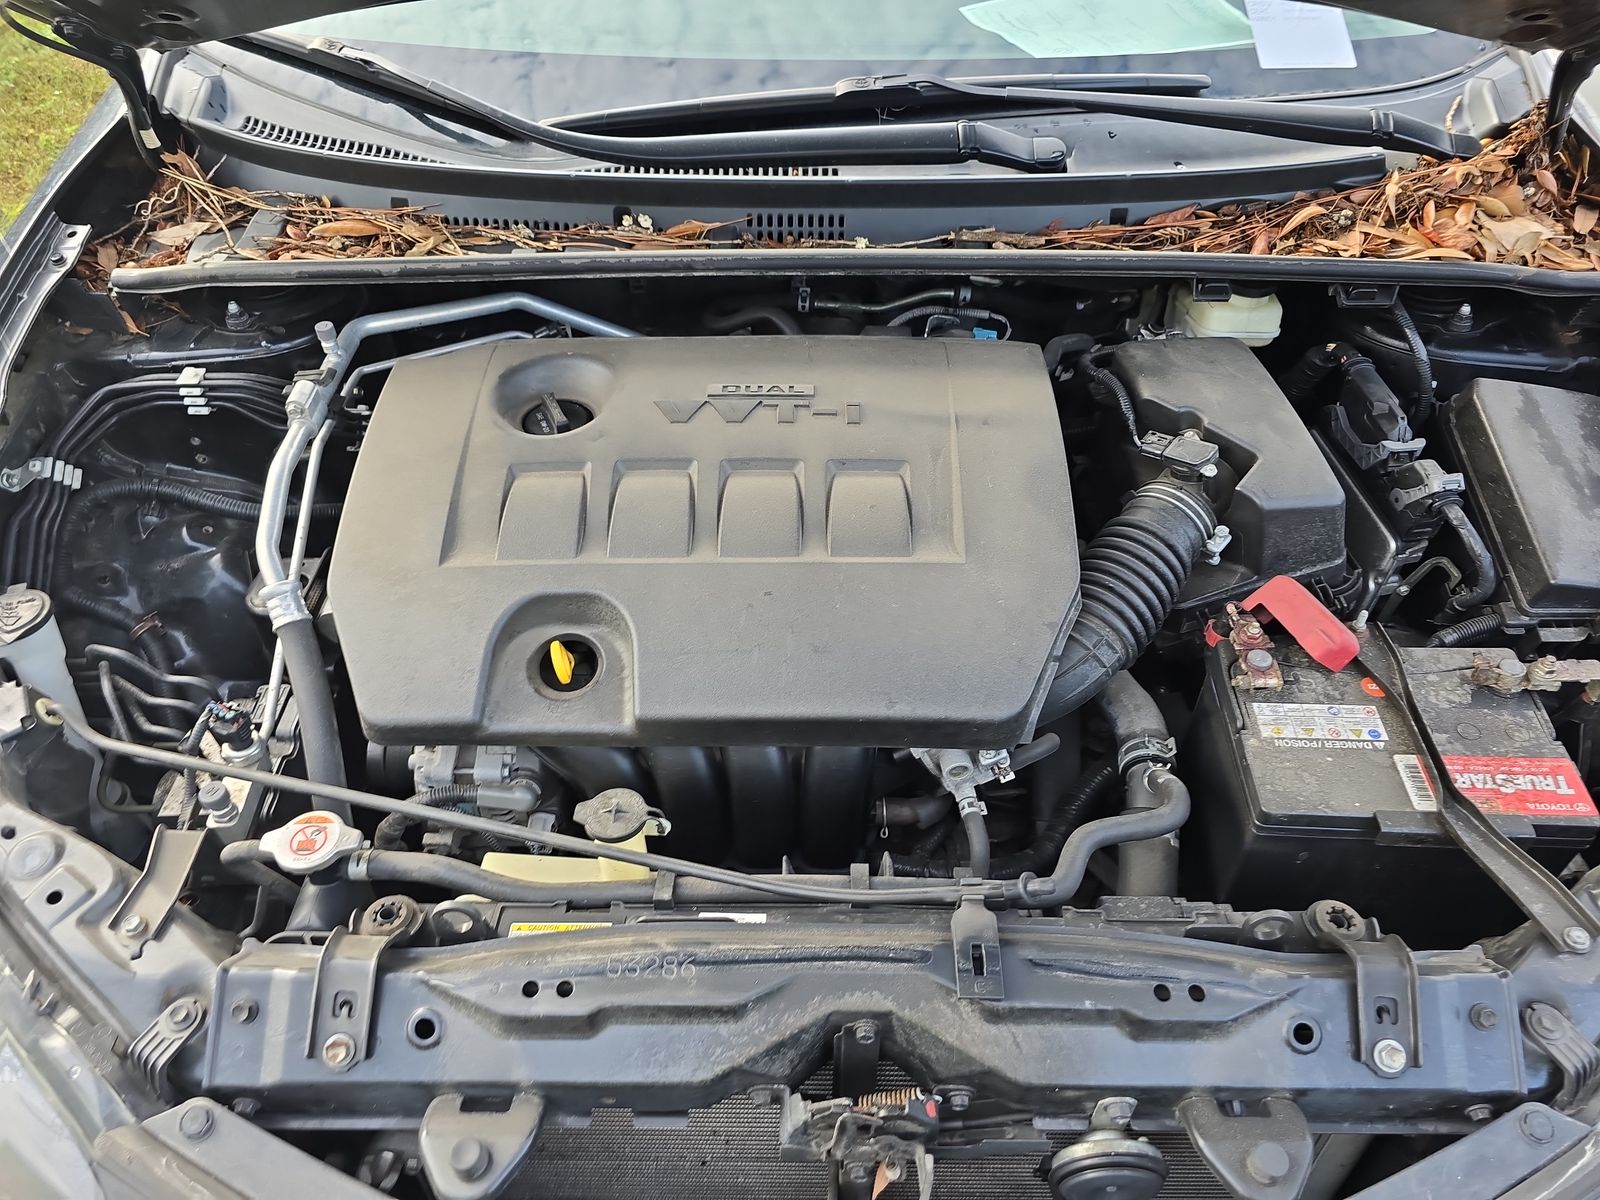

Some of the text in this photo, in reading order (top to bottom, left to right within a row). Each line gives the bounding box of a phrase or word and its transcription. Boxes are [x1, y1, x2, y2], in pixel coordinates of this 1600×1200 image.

[721, 385, 805, 394] DUAL
[1324, 740, 1373, 750] DANGER
[1526, 802, 1575, 811] TOYOTA
[527, 924, 560, 932] CAUTION
